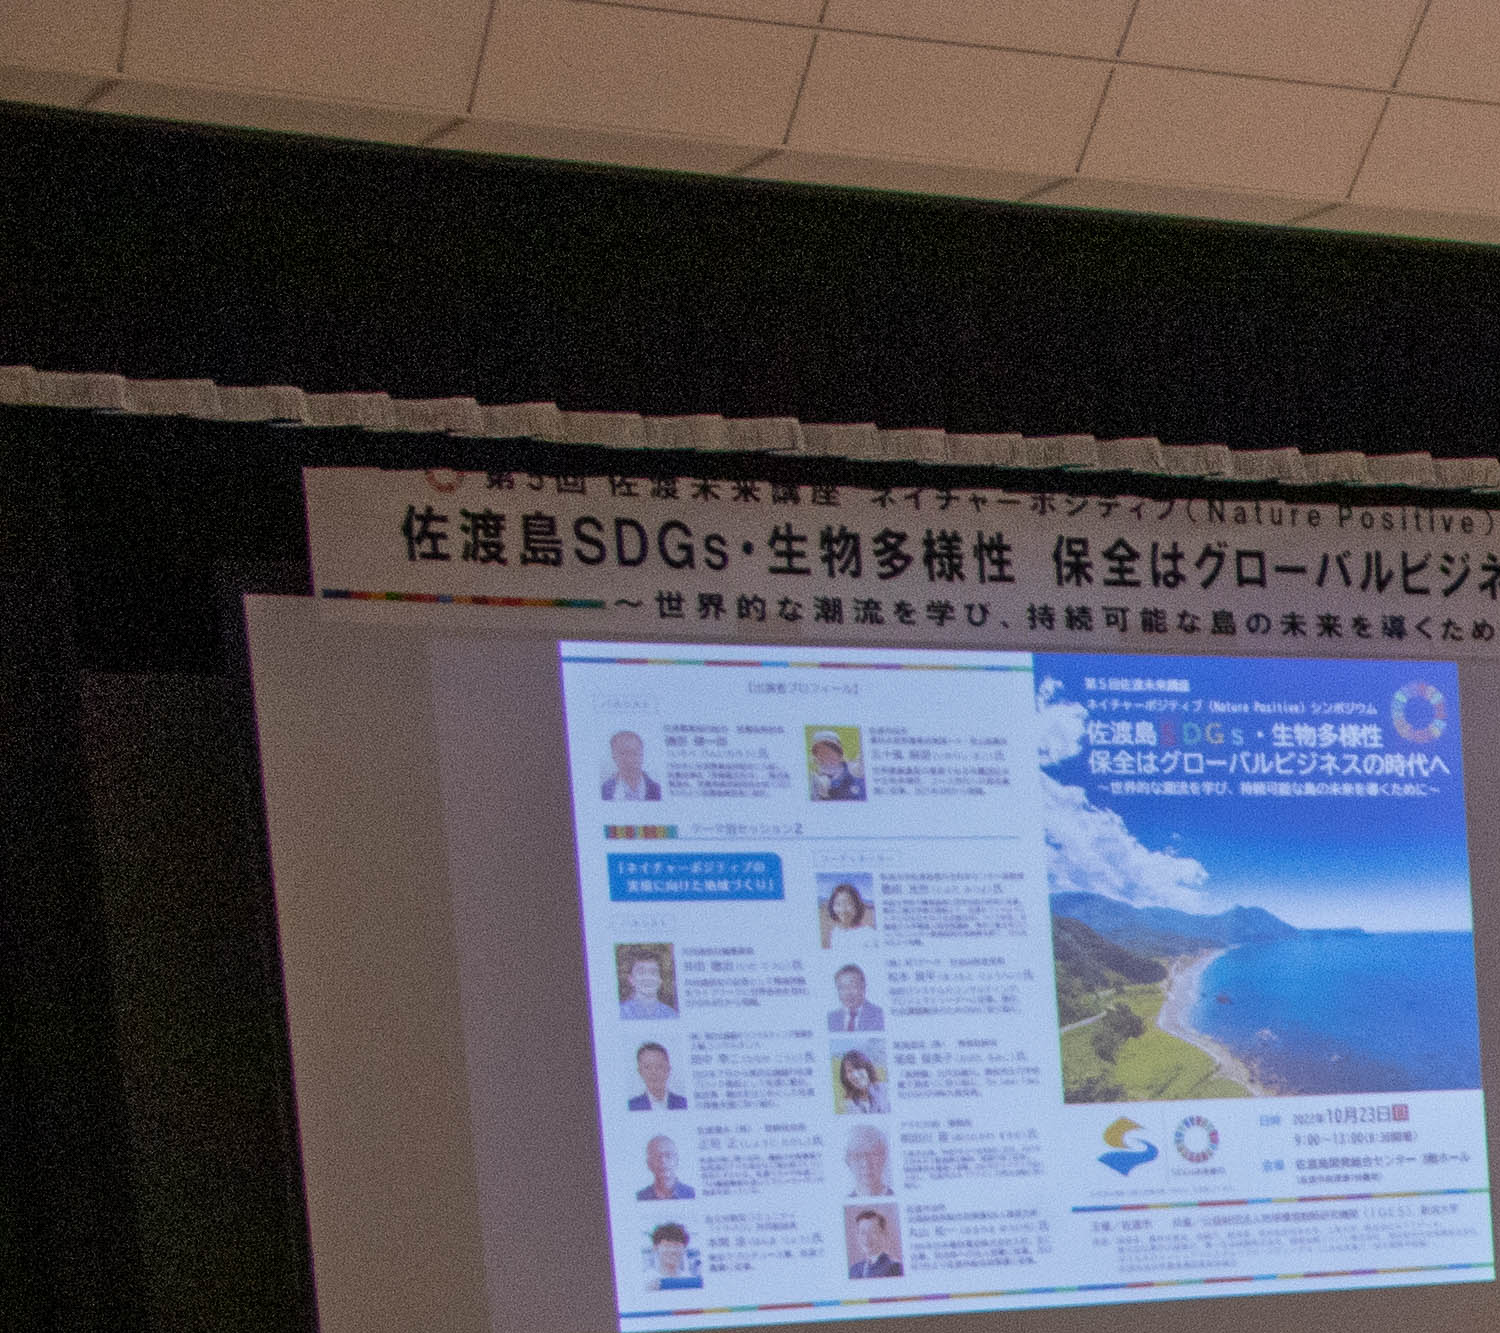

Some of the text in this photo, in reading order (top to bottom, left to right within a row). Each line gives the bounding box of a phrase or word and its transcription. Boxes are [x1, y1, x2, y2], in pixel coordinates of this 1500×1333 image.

[402, 504, 1016, 585] 佐渡島SDGs・生物多様性
[1088, 749, 1451, 777] 保全はグローバルビジネスの時代へ
